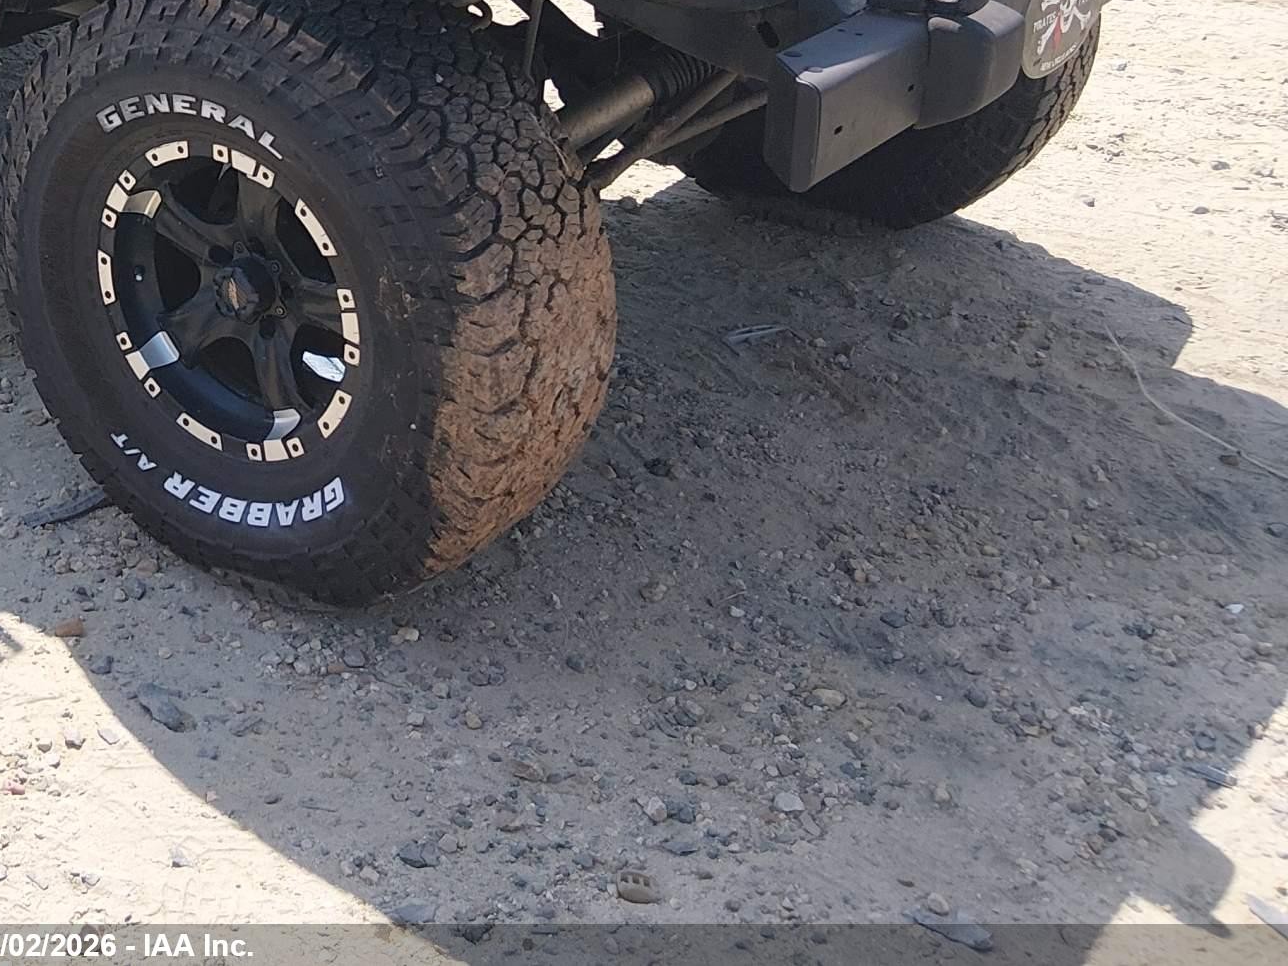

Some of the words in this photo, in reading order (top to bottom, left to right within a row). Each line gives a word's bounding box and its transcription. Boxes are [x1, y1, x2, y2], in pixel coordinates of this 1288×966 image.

[96, 92, 284, 161] GENERAL
[111, 431, 158, 472] A/T
[162, 470, 345, 527] GRABBER
